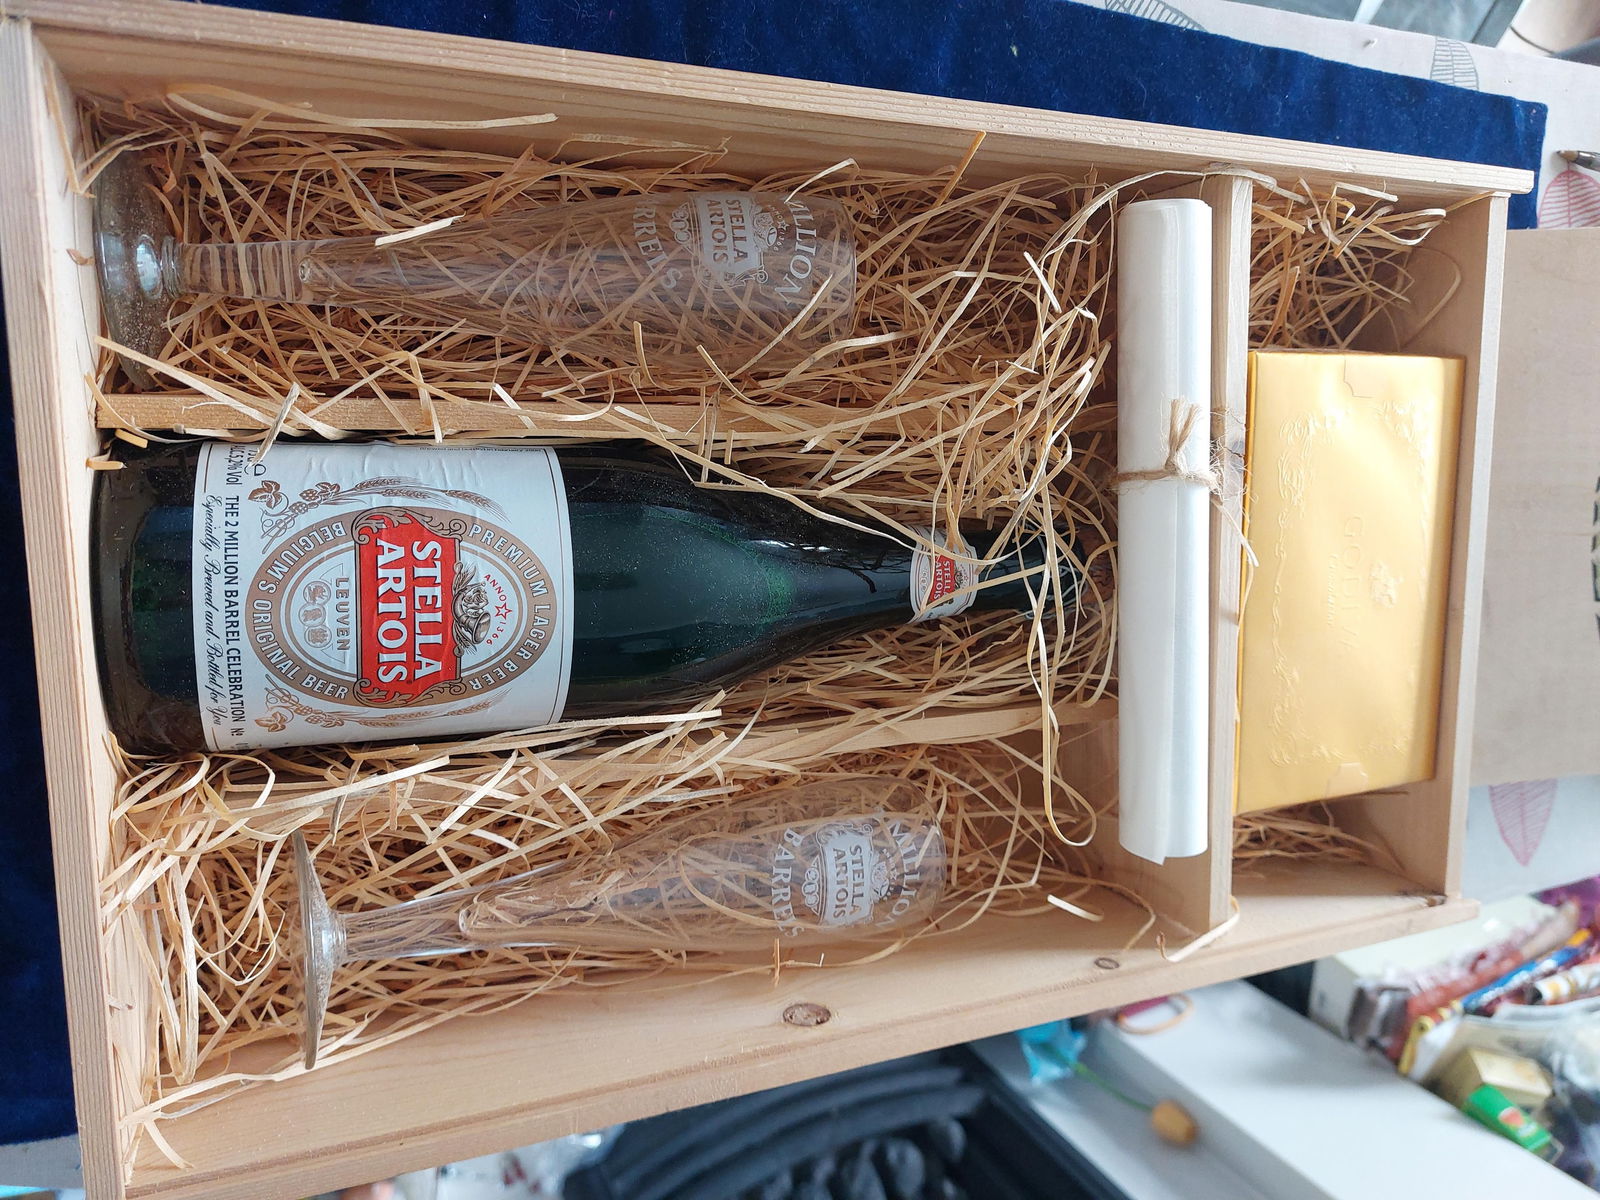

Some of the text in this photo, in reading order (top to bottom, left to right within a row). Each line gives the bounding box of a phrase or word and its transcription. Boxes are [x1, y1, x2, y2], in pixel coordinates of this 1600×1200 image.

[707, 199, 728, 264] ARTOIS
[724, 199, 748, 263] STELLA
[224, 495, 240, 517] THE
[226, 471, 243, 485] Vol
[223, 531, 239, 586] MILLION
[934, 562, 943, 600] ARTOIS
[199, 495, 228, 726] Especially Brewed and Bottled for You
[224, 590, 241, 645] BARREL
[251, 522, 350, 700] BELGIUM'S ORIGINAL BEER
[334, 577, 350, 651] LEUVEN
[376, 539, 408, 683] ARTOIS
[412, 539, 442, 681] STELLA
[468, 524, 551, 691] PREMIUM LAGER BEER
[484, 574, 507, 646] ANNO 1366
[226, 648, 246, 722] CELEBRATION
[770, 827, 805, 938] BARRELS
[832, 847, 850, 919] ARTOIS
[849, 845, 865, 916] STELLA
